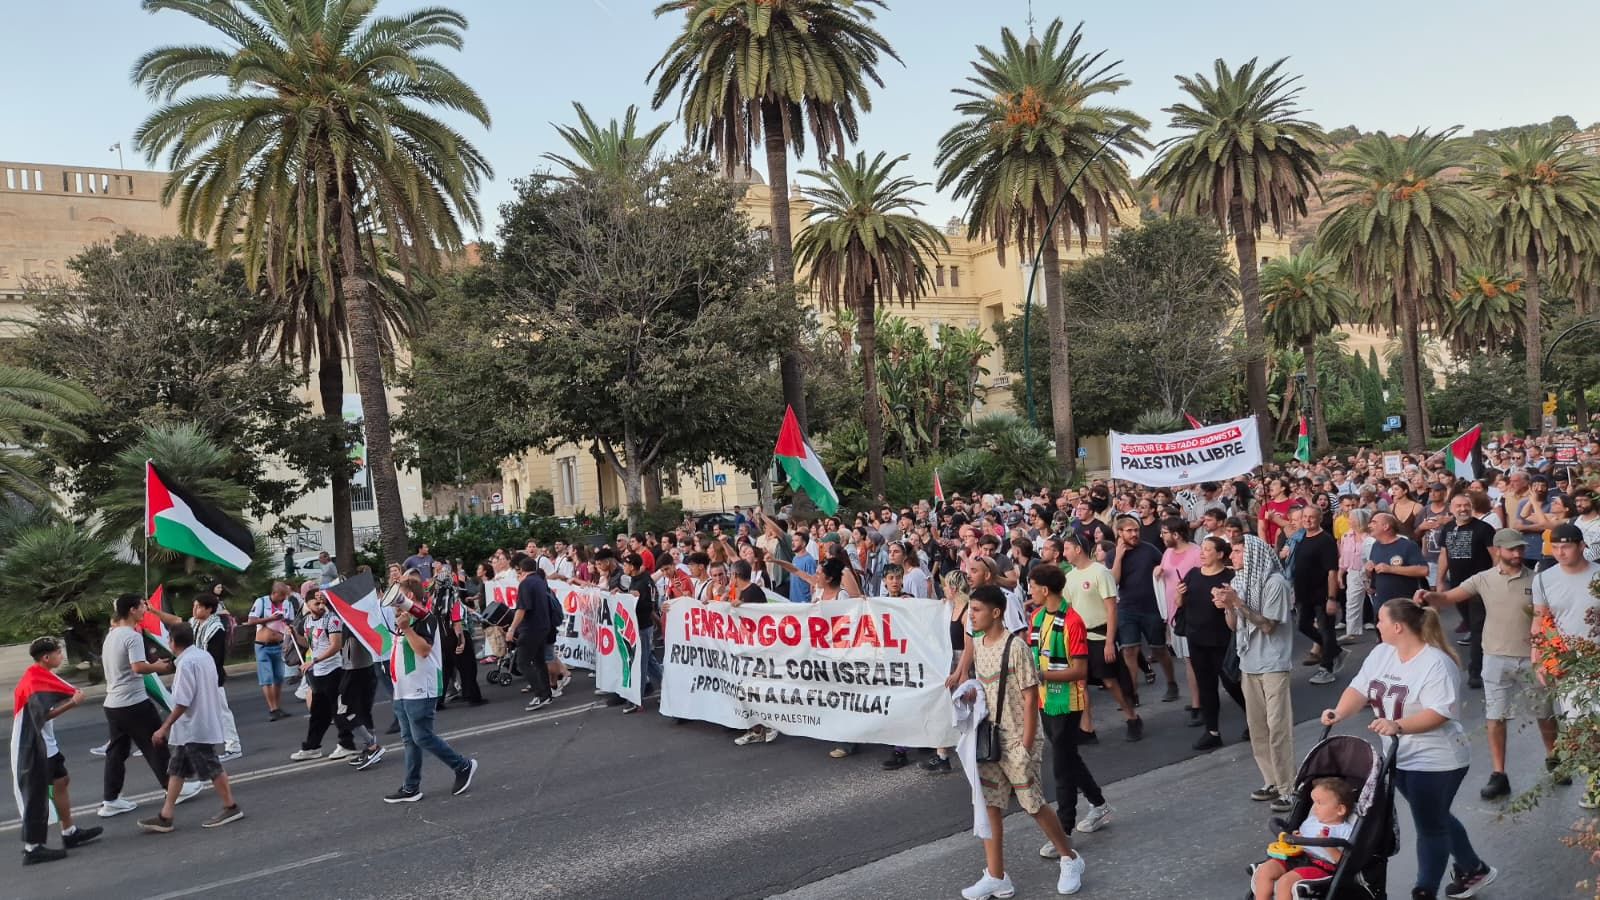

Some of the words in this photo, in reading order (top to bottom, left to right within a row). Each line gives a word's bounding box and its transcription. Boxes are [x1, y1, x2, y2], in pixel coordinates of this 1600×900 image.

[1155, 443, 1164, 451] EL
[1165, 440, 1198, 450] ESTADO
[1199, 429, 1239, 445] SIONISTA
[1121, 452, 1198, 470] PALESTINA
[1199, 441, 1245, 463] LIBRE
[808, 613, 907, 654] REAL,
[670, 644, 729, 672] RUPTURA
[786, 659, 830, 682] CON
[832, 661, 924, 688] ISRAEL!
[765, 687, 778, 703] A
[780, 687, 804, 706] LA
[806, 689, 892, 716] FLOTILLA!
[774, 713, 821, 726] PALESTINA
